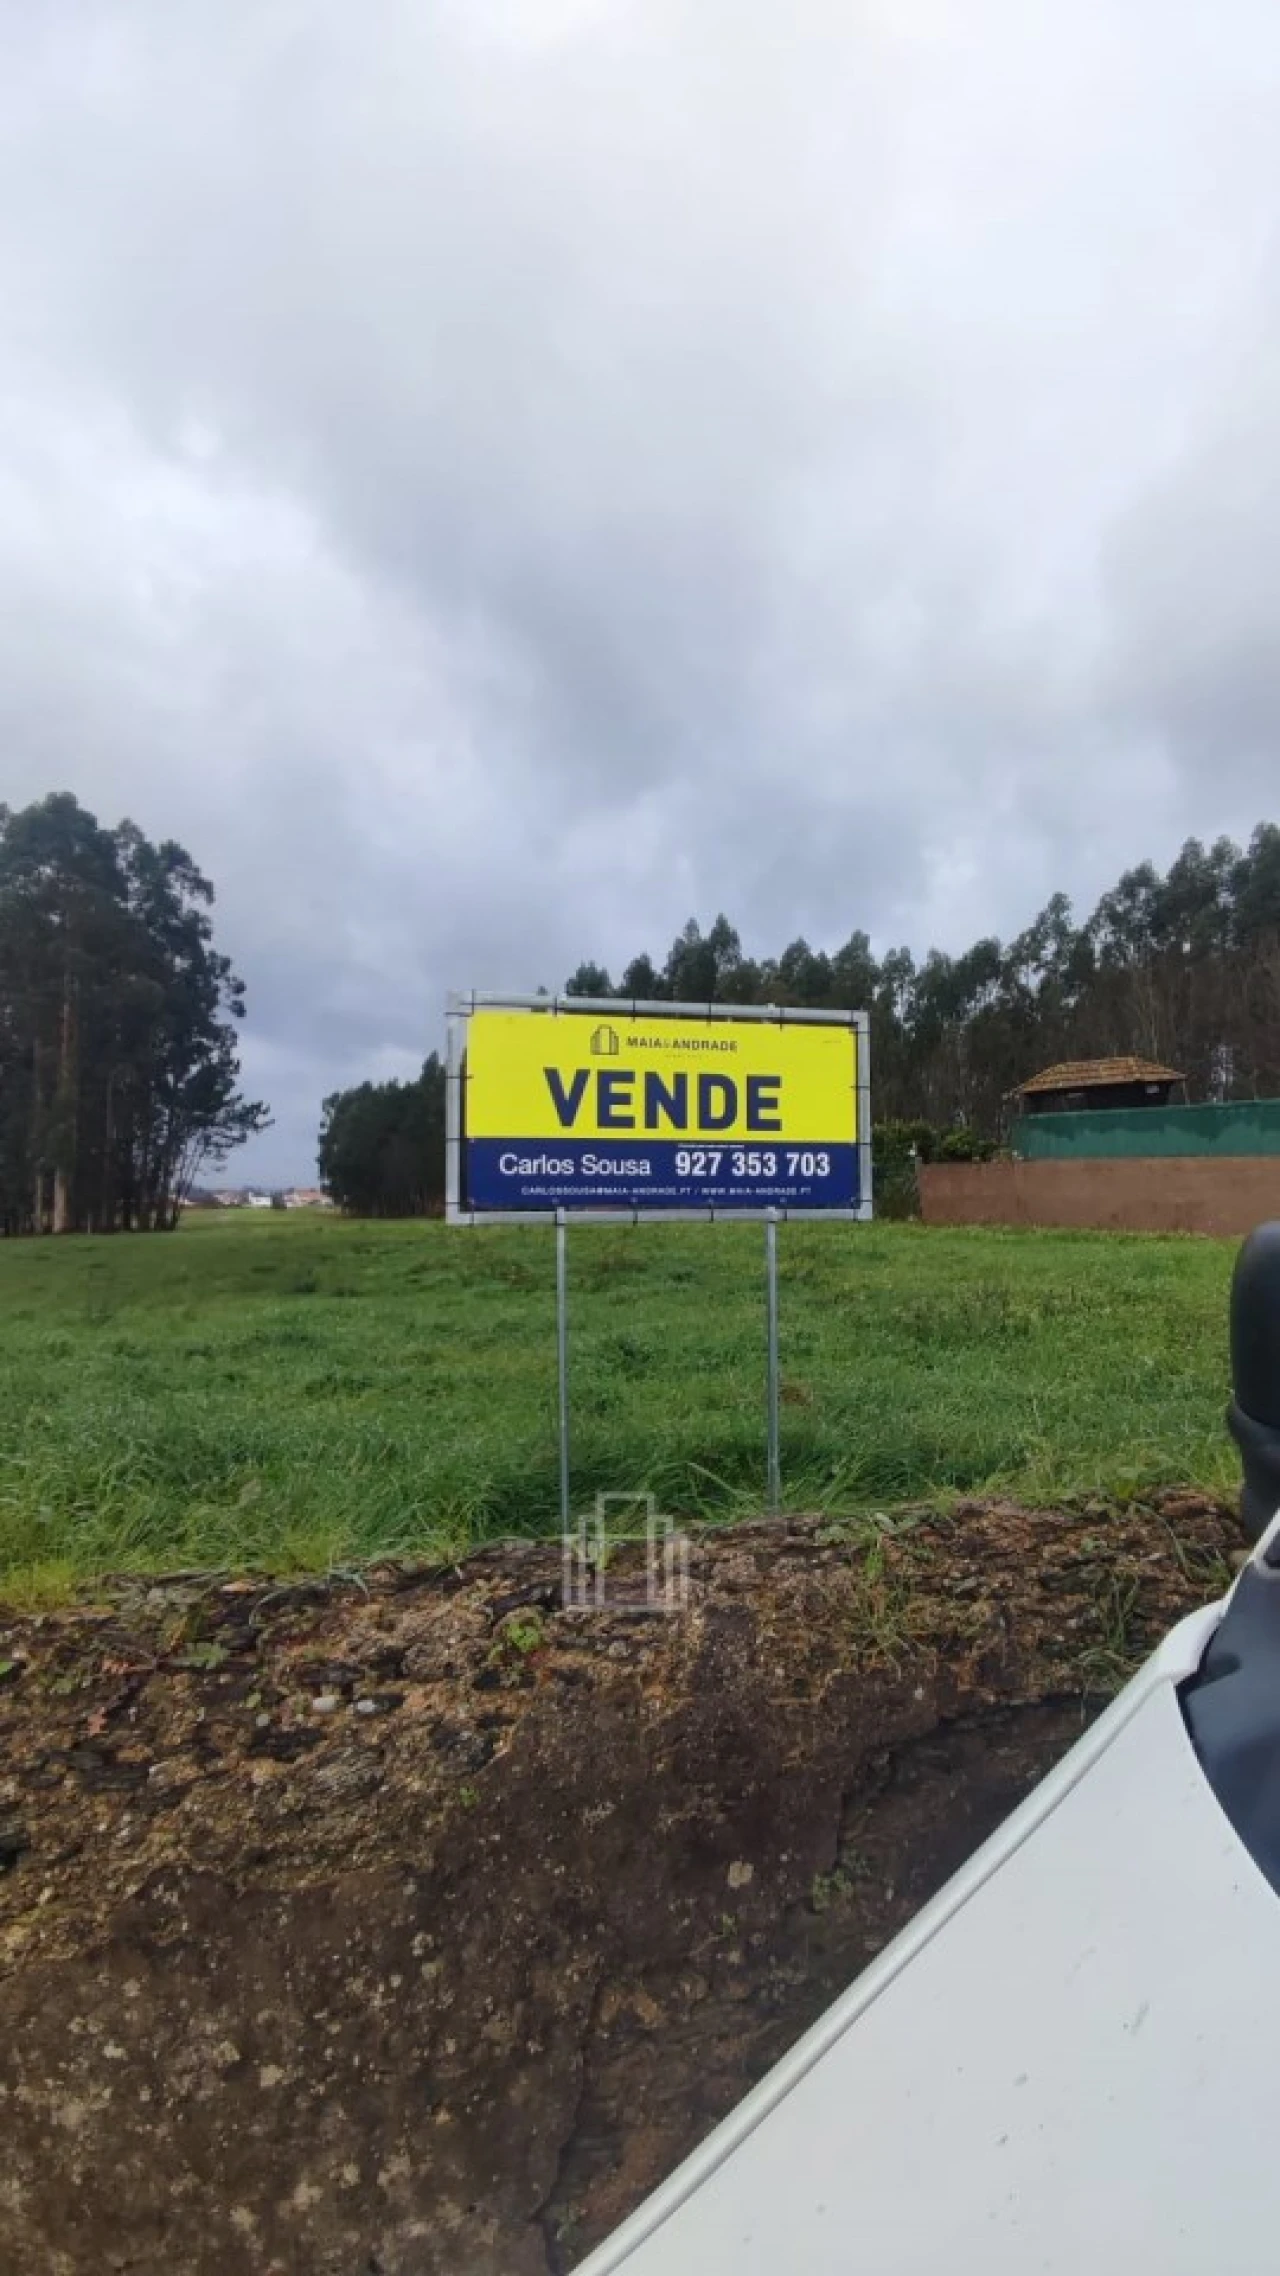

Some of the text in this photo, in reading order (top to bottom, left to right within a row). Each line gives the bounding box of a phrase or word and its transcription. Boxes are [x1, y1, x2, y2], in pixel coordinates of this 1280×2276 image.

[543, 1067, 783, 1132] VENDE
[499, 1151, 831, 1177] Carlos Sousa 927 353 703
